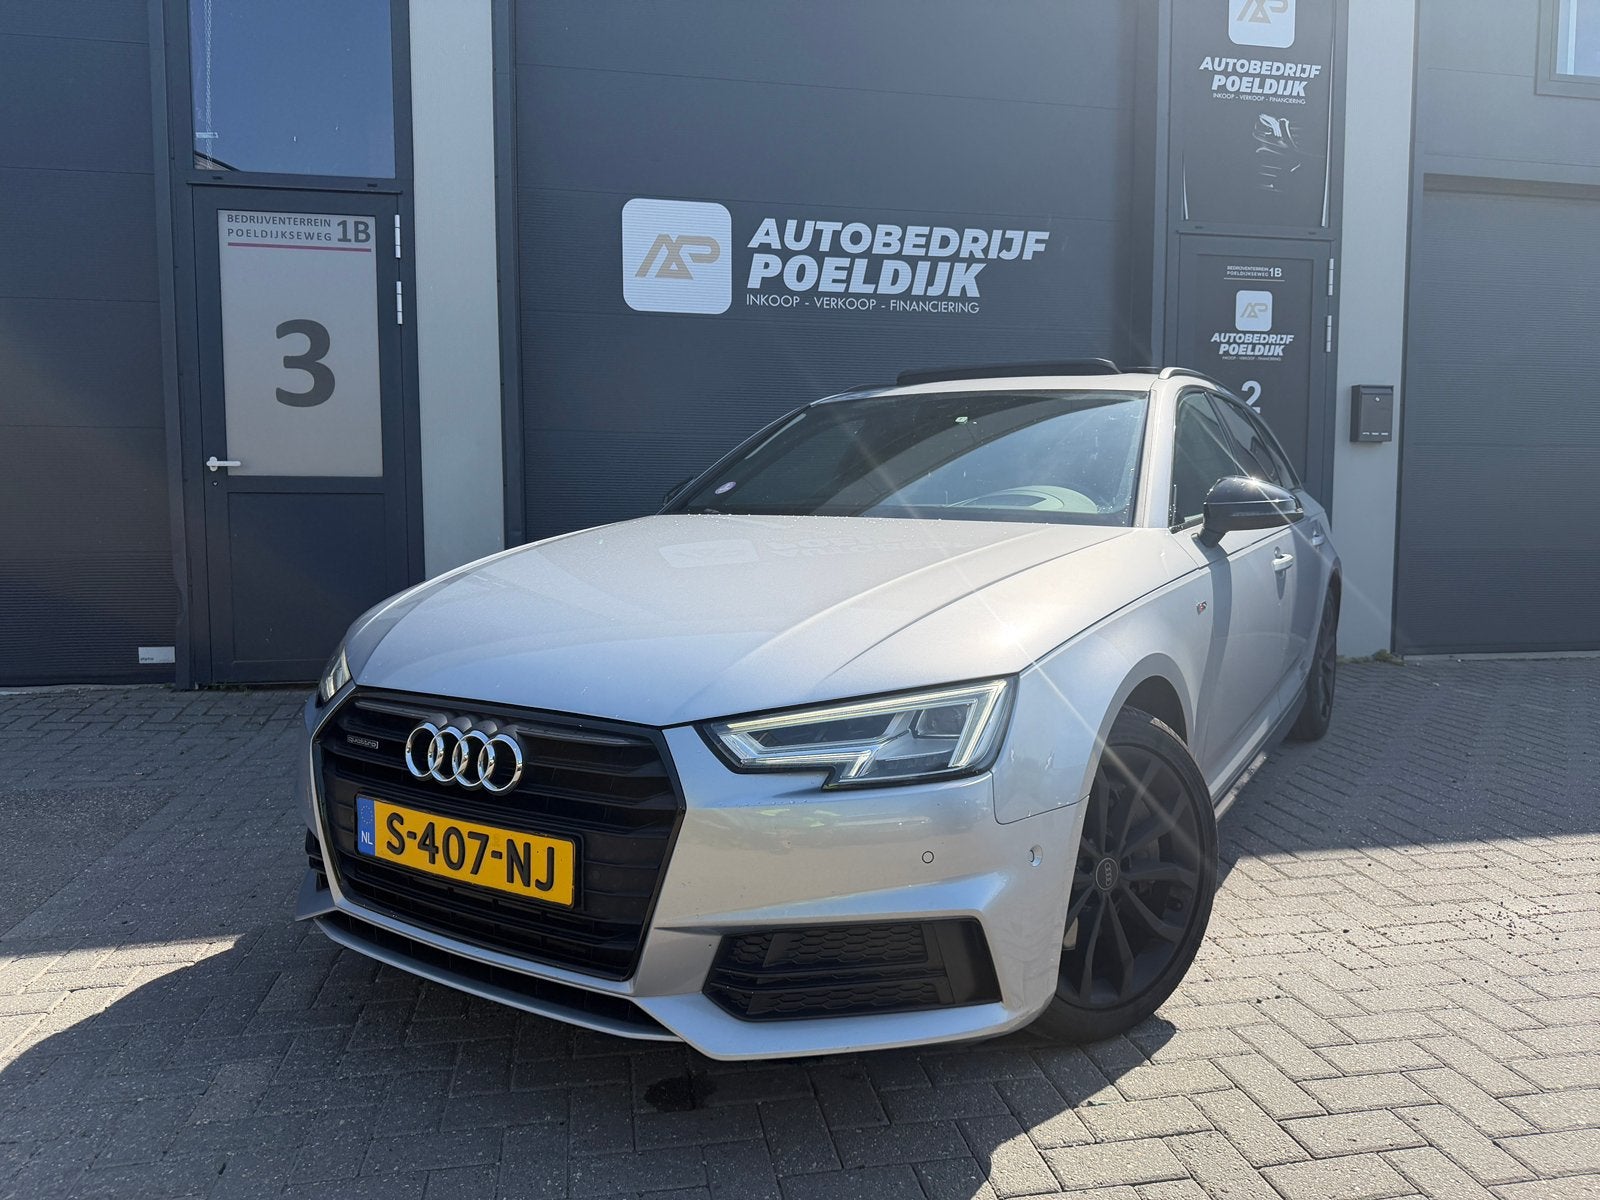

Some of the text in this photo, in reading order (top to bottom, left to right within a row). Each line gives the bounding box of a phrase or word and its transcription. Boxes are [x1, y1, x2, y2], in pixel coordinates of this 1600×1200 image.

[1199, 57, 1321, 78] AUTOBEDRIJF
[1211, 75, 1308, 97] POELDIJK
[227, 214, 331, 227] BEDRIJVENTERREIN
[227, 219, 371, 243] POELDIJKSEWEG 1B
[747, 217, 1050, 261] AUTOBEDRIJF
[747, 253, 987, 298] POELDIJK
[1269, 267, 1282, 277] 1B
[746, 294, 800, 307] INKOOP
[814, 297, 876, 311] VERKOOP
[890, 299, 980, 314] FINANCIERING
[1210, 332, 1295, 345] AUTOBEDRIJF
[1218, 343, 1286, 356] POELDIJK
[276, 319, 335, 407] 3
[1241, 380, 1262, 414] 2
[361, 830, 374, 846] NL
[386, 812, 555, 892] S-407-NJ
